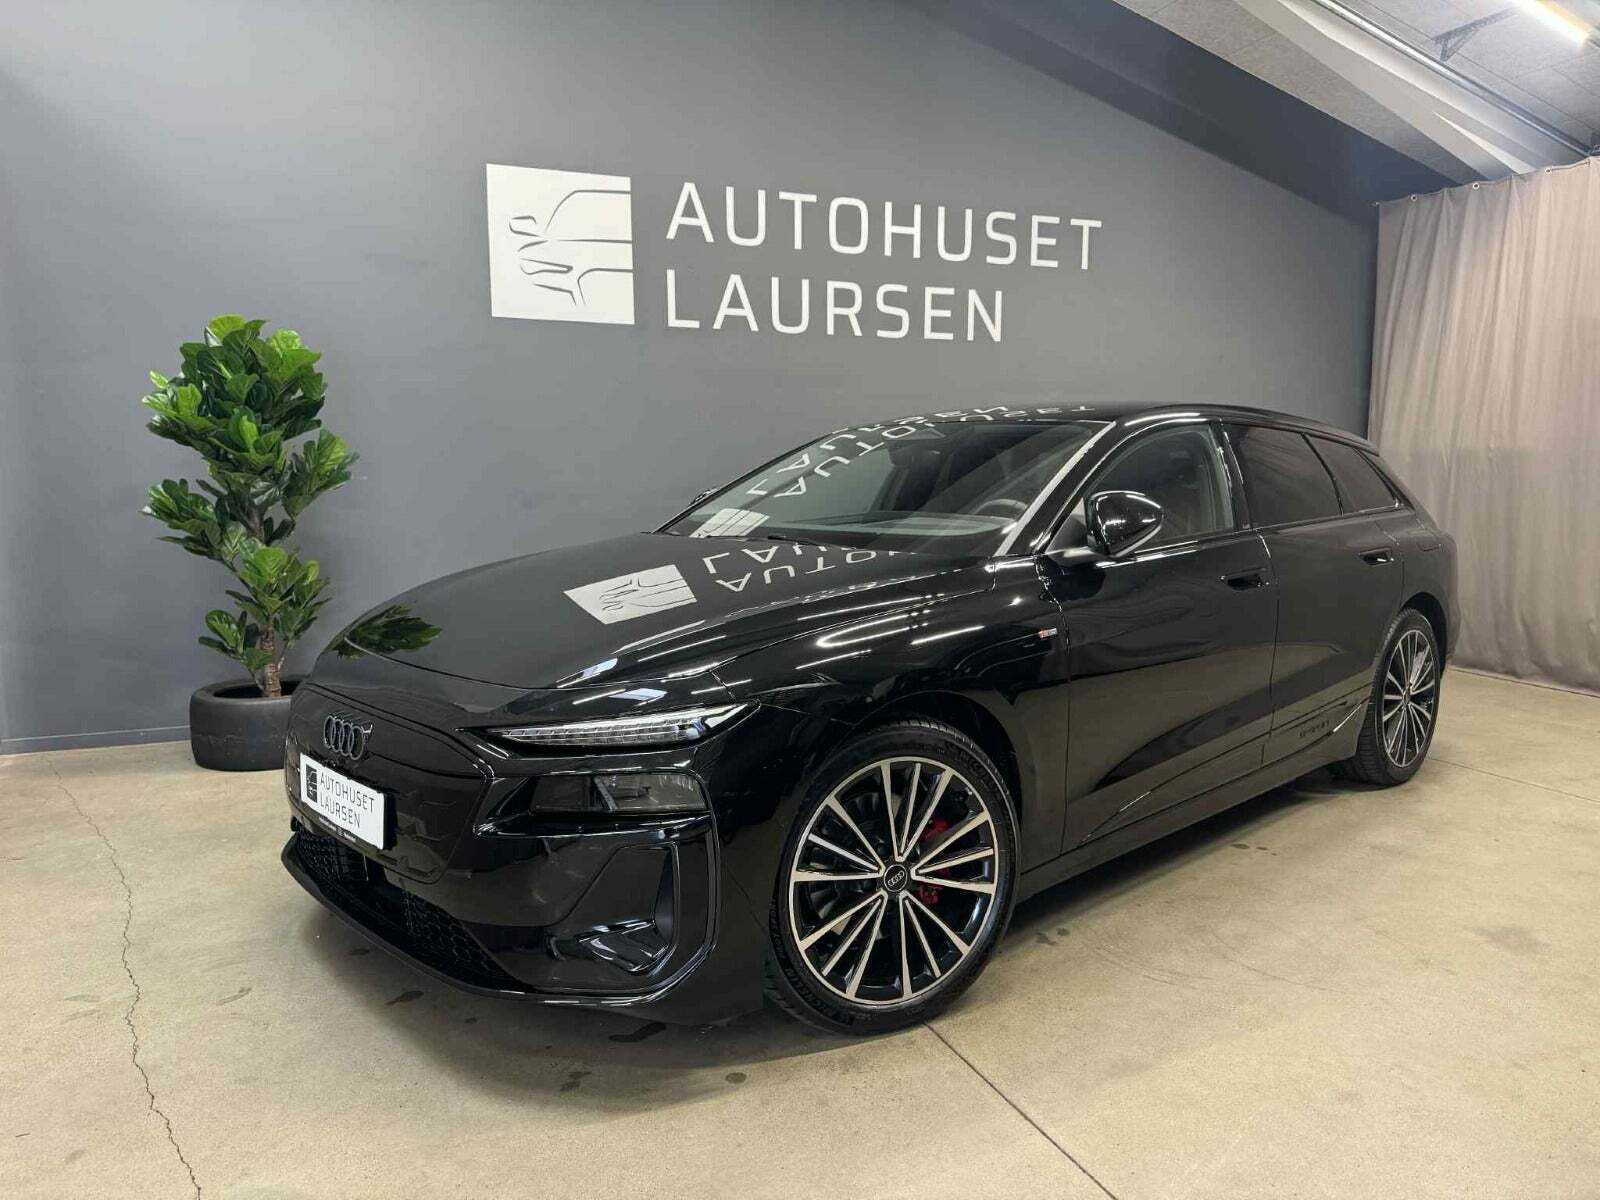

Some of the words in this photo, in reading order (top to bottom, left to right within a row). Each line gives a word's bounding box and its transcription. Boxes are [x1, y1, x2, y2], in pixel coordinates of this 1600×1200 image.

[666, 181, 1103, 270] AUTOHUSET
[666, 268, 1004, 342] LAURSEN
[320, 772, 374, 813] AUTOHUSET
[320, 794, 360, 828] LAURSEN
